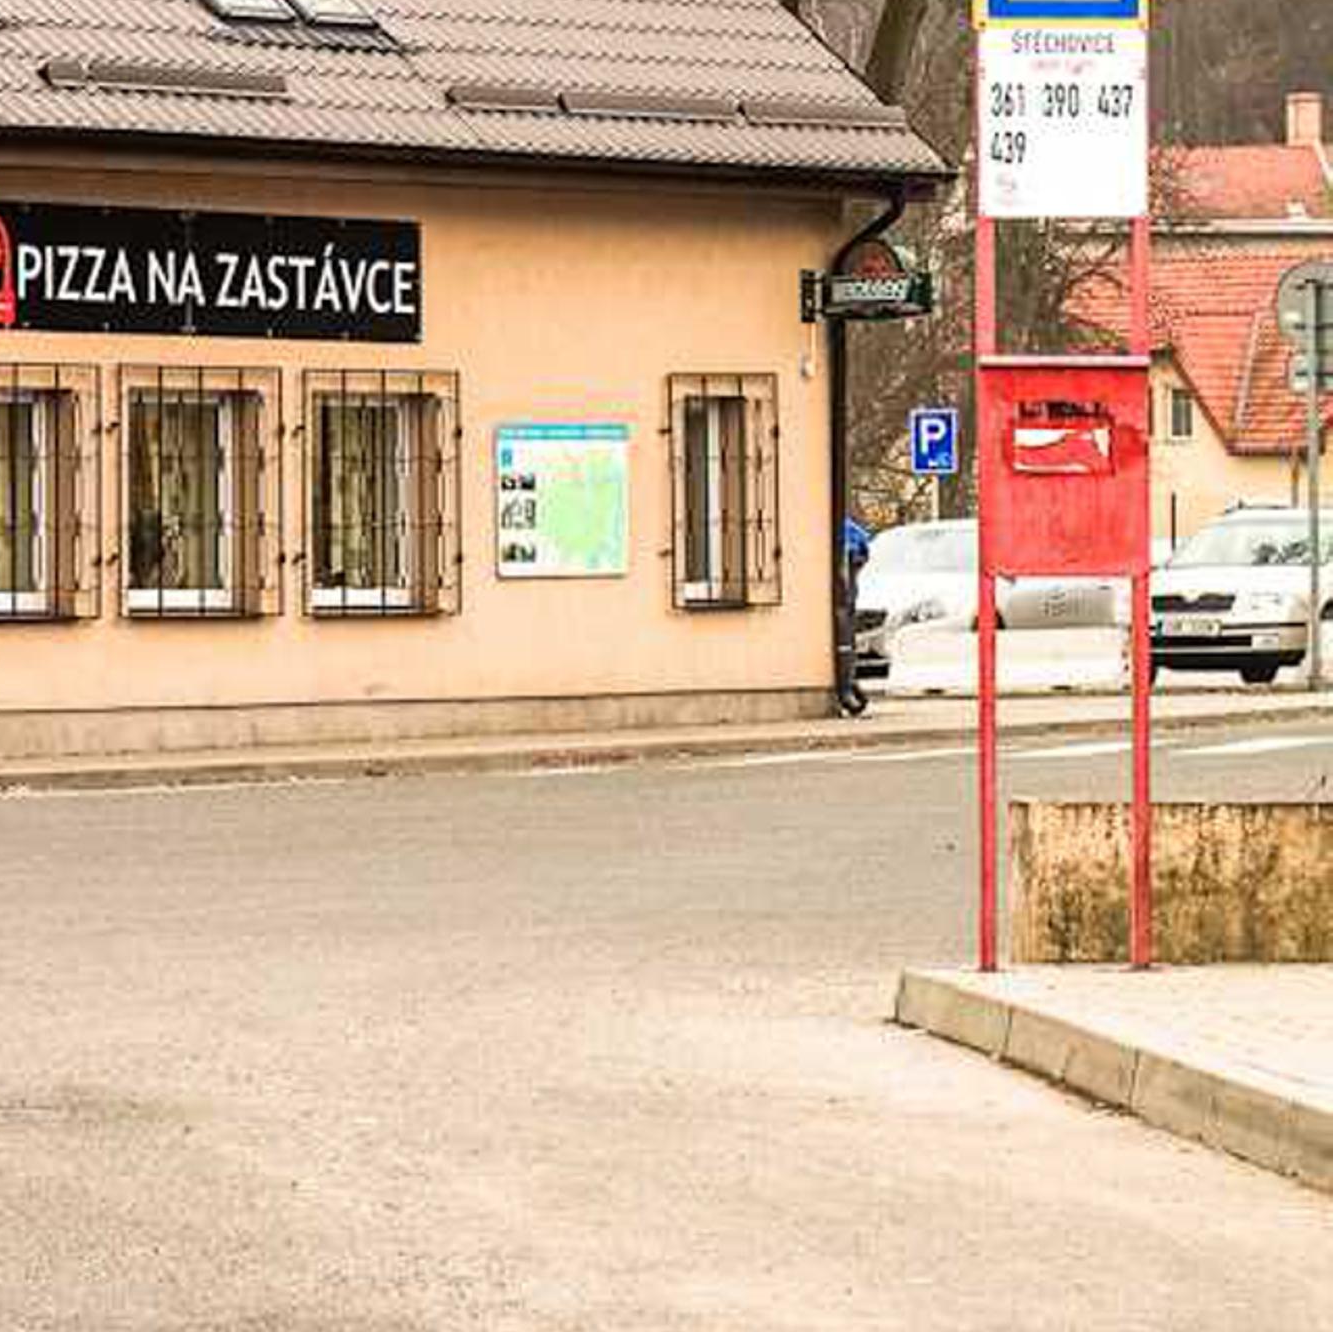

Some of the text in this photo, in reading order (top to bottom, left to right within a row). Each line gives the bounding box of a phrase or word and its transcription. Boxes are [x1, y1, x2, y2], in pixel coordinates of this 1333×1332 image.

[990, 81, 1134, 118] 361 390 437
[990, 130, 1027, 165] 439
[17, 242, 418, 314] PIZZA NA ZASTÁVCE
[919, 418, 947, 455] P
